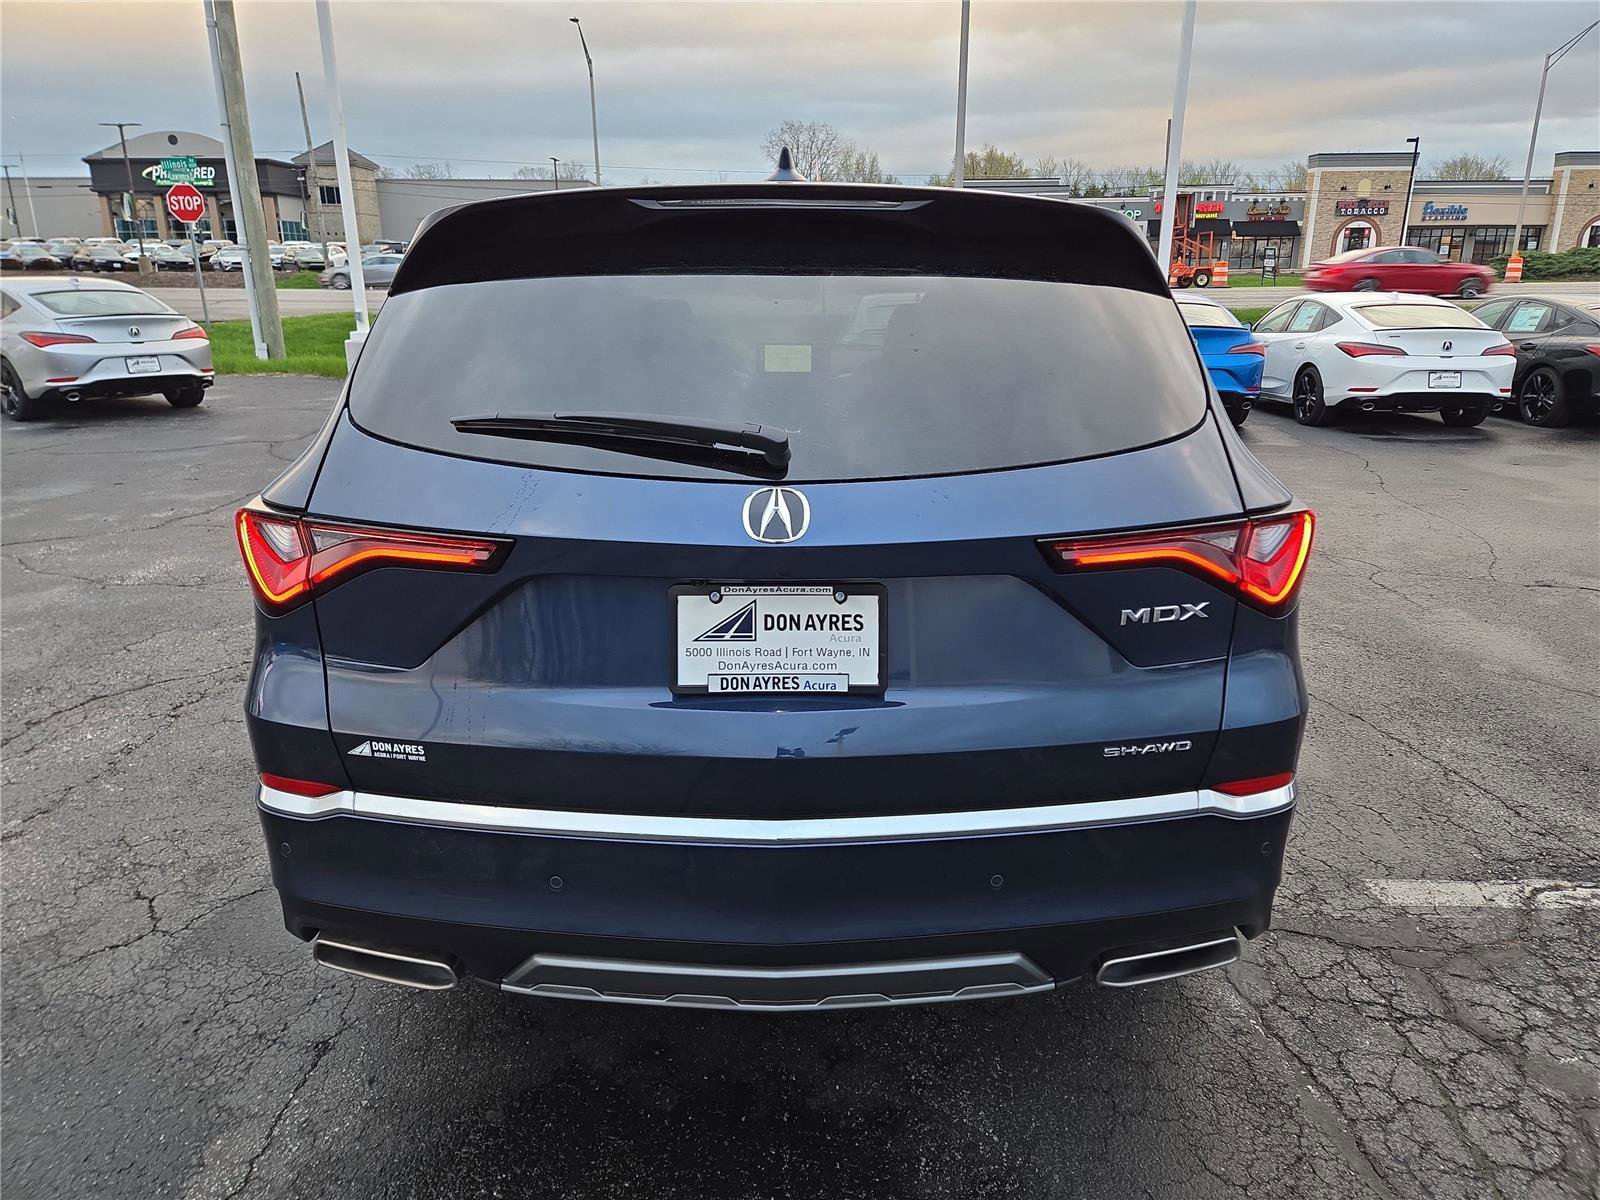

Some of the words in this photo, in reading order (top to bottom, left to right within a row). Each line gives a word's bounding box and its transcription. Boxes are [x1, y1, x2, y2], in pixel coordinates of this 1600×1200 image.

[161, 159, 187, 169] Illinois
[152, 165, 215, 180] PRRED
[170, 196, 201, 210] STOP
[723, 586, 832, 594] DonAyresAcura.com
[1120, 602, 1210, 626] MDX
[764, 614, 800, 631] DON
[804, 614, 864, 631] AYRES
[829, 634, 862, 643] Acura
[685, 647, 712, 657] 5000
[716, 647, 751, 657] Illinois
[755, 647, 782, 657] Road
[792, 647, 813, 657] Fort
[816, 647, 855, 659] Wayne,
[859, 648, 870, 657] IN
[718, 661, 837, 672] DonAyresAcura.com
[720, 676, 750, 691] DON
[753, 676, 800, 691] AYRES
[803, 679, 837, 691] Acura
[371, 741, 392, 752] DON
[393, 743, 425, 755] AYRES
[1103, 740, 1193, 757] SH-AWD
